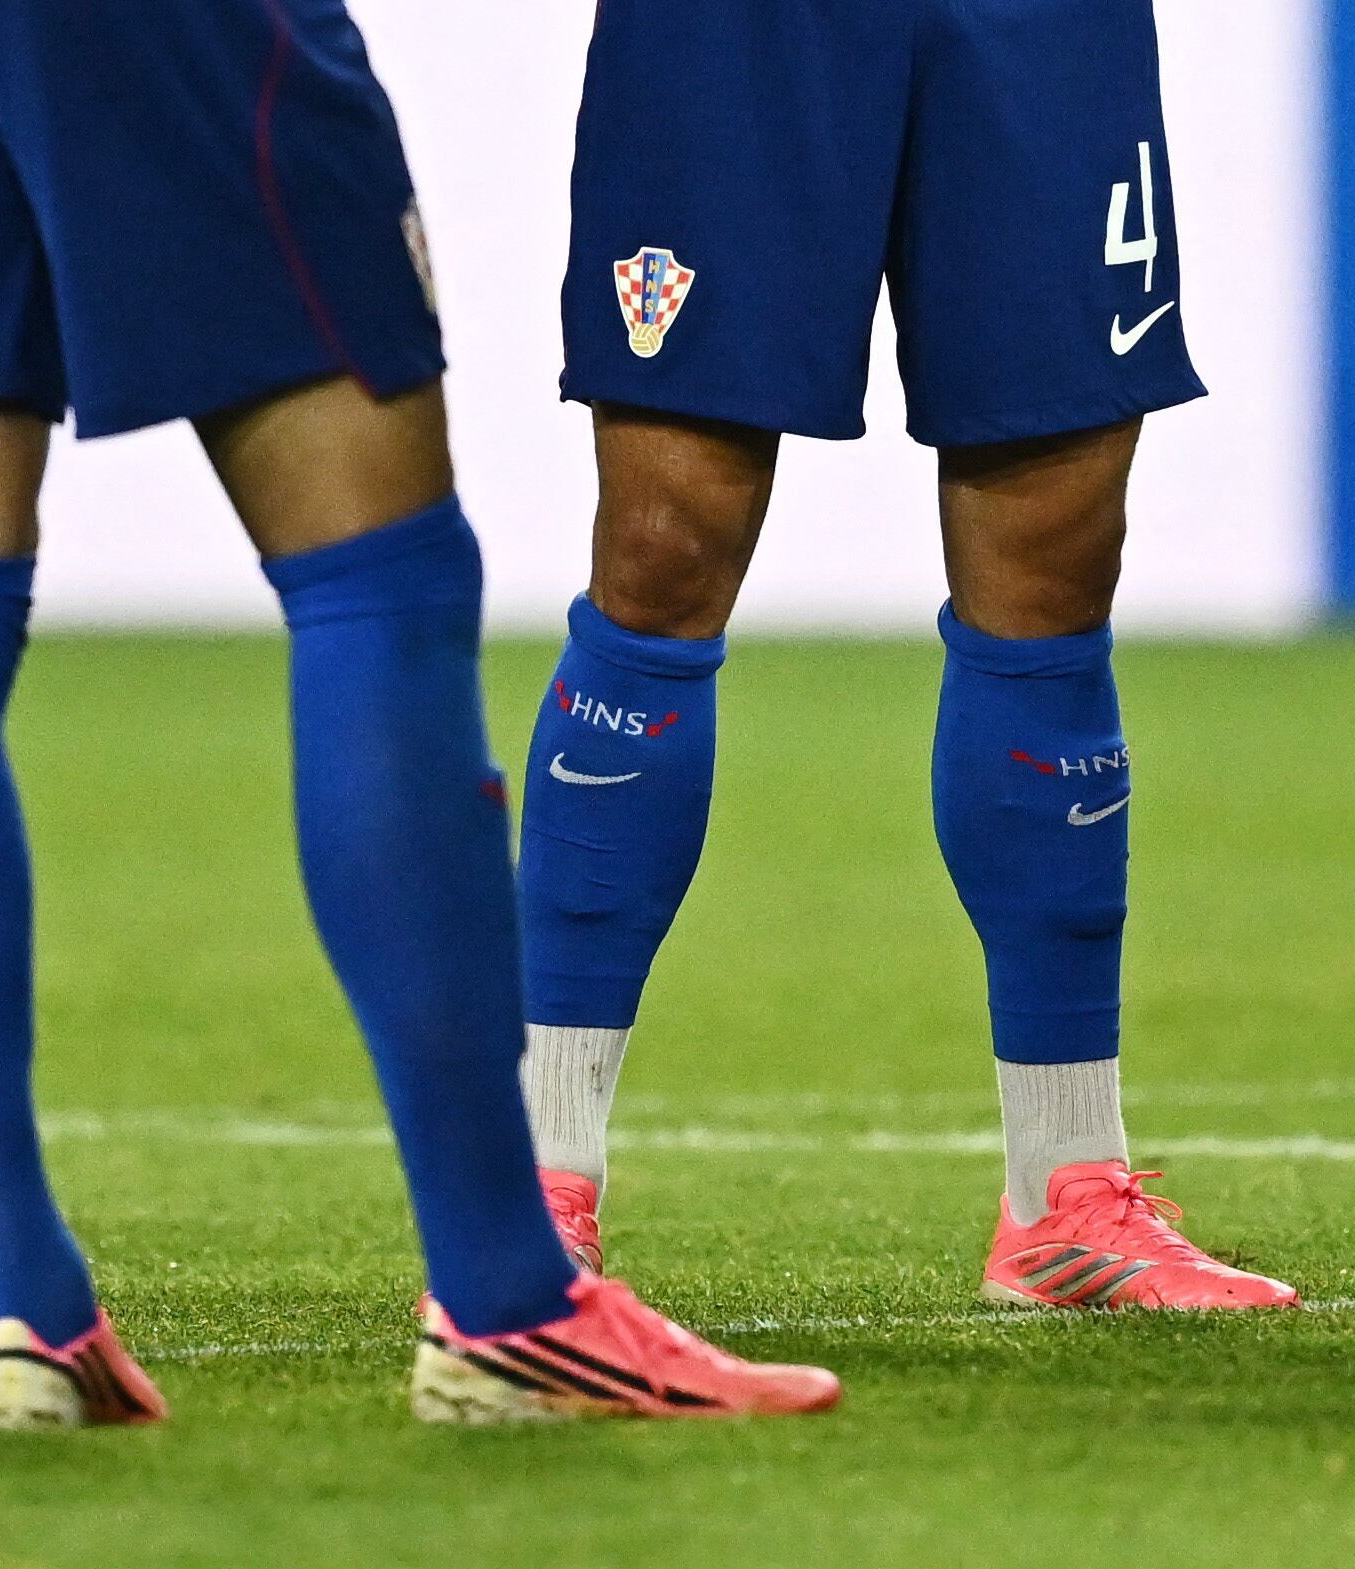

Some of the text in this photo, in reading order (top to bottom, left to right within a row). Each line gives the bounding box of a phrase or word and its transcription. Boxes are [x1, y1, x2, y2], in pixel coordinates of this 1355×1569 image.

[1104, 140, 1158, 293] 4
[644, 259, 661, 313] HNS
[570, 690, 647, 736] HNS
[1059, 744, 1131, 777] HNS
